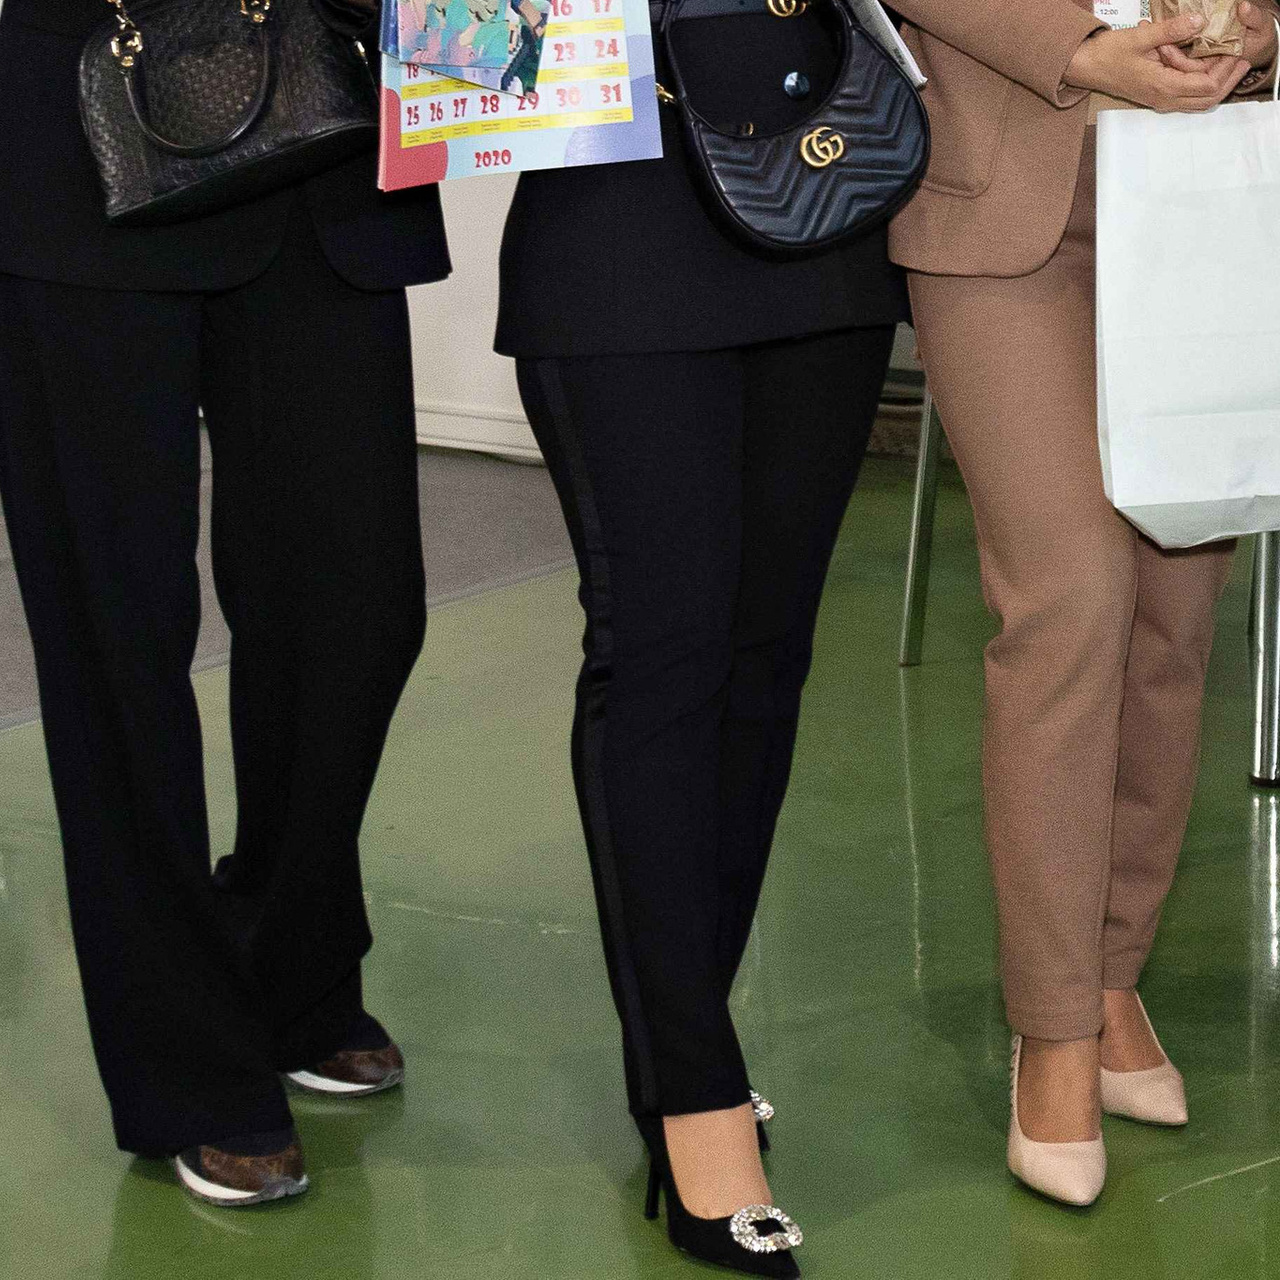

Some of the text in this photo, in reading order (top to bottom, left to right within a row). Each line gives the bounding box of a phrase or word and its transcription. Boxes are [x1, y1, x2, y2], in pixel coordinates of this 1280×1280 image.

[1099, 8, 1119, 16] 12:00
[553, 38, 620, 62] 23 24
[406, 105, 420, 126] 25
[429, 101, 444, 122] 26
[453, 98, 468, 118] 27
[480, 94, 500, 114] 28
[600, 83, 623, 103] 31
[475, 148, 512, 168] 2020
